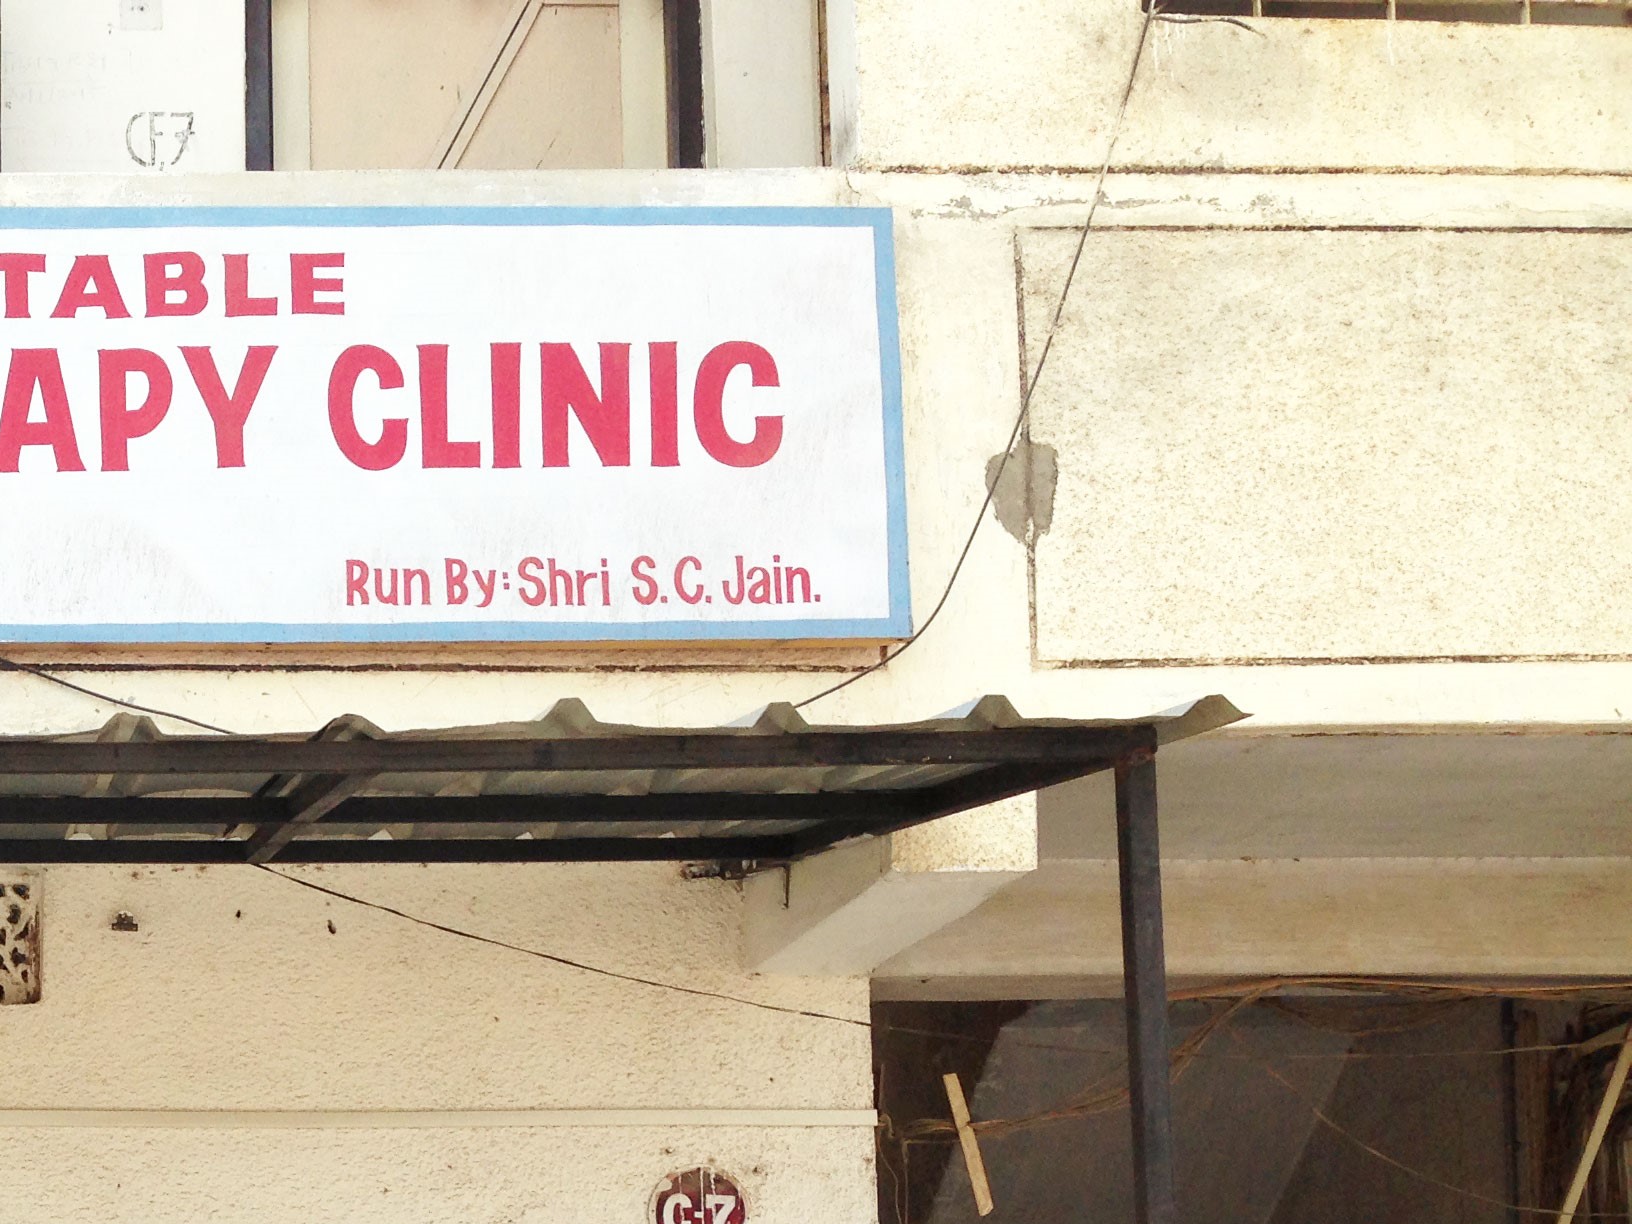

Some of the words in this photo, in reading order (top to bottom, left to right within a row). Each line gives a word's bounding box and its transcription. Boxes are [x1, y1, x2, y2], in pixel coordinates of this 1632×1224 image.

[327, 340, 784, 472] CLINIC
[345, 558, 432, 608] Run
[722, 553, 823, 606] Jain.
